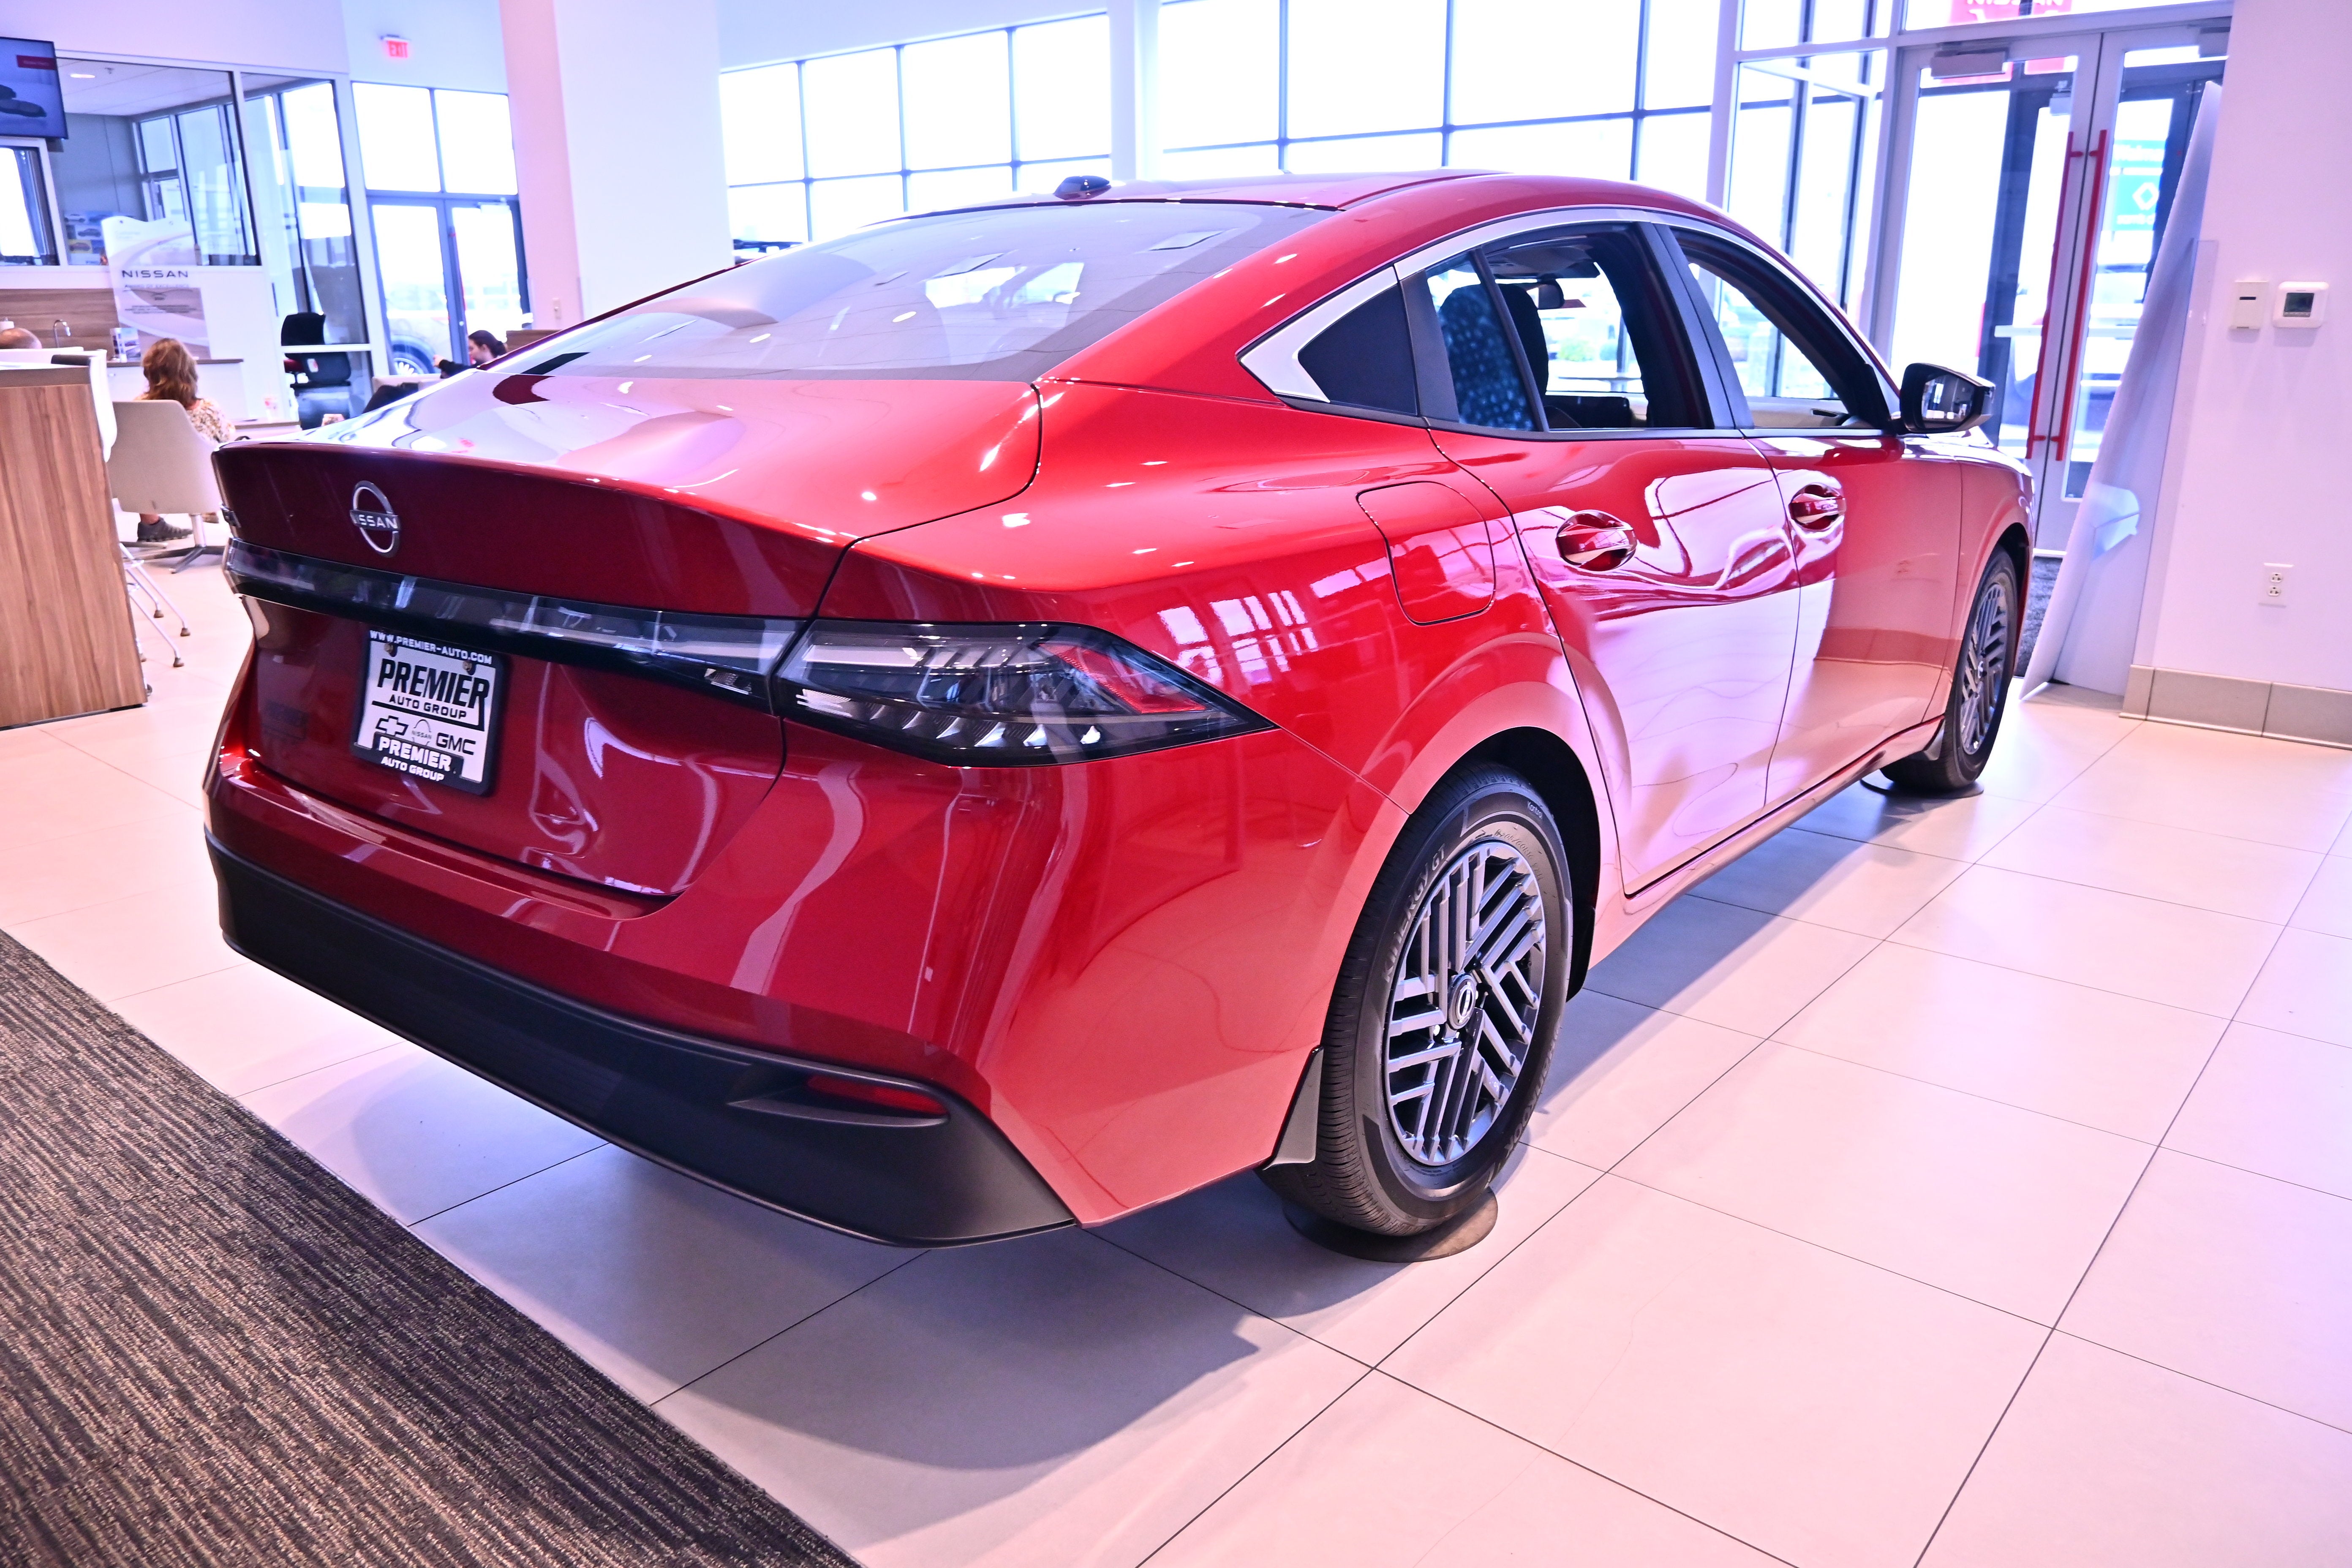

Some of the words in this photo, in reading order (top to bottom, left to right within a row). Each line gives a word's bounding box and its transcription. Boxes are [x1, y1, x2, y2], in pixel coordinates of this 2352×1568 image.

[389, 41, 408, 58] EXIT
[121, 270, 188, 278] NISSAN
[370, 630, 492, 664] WWW.PREMIER-AUTO.COM
[377, 658, 490, 709] PREMIER
[389, 694, 419, 709] AUTO
[424, 702, 467, 719] GROUP
[411, 730, 432, 739] NISSAN
[436, 732, 476, 755] GMC
[378, 736, 452, 772] PREMIER
[381, 757, 408, 771] AUTO
[409, 764, 445, 781] GROUP
[1432, 843, 1446, 871] GT
